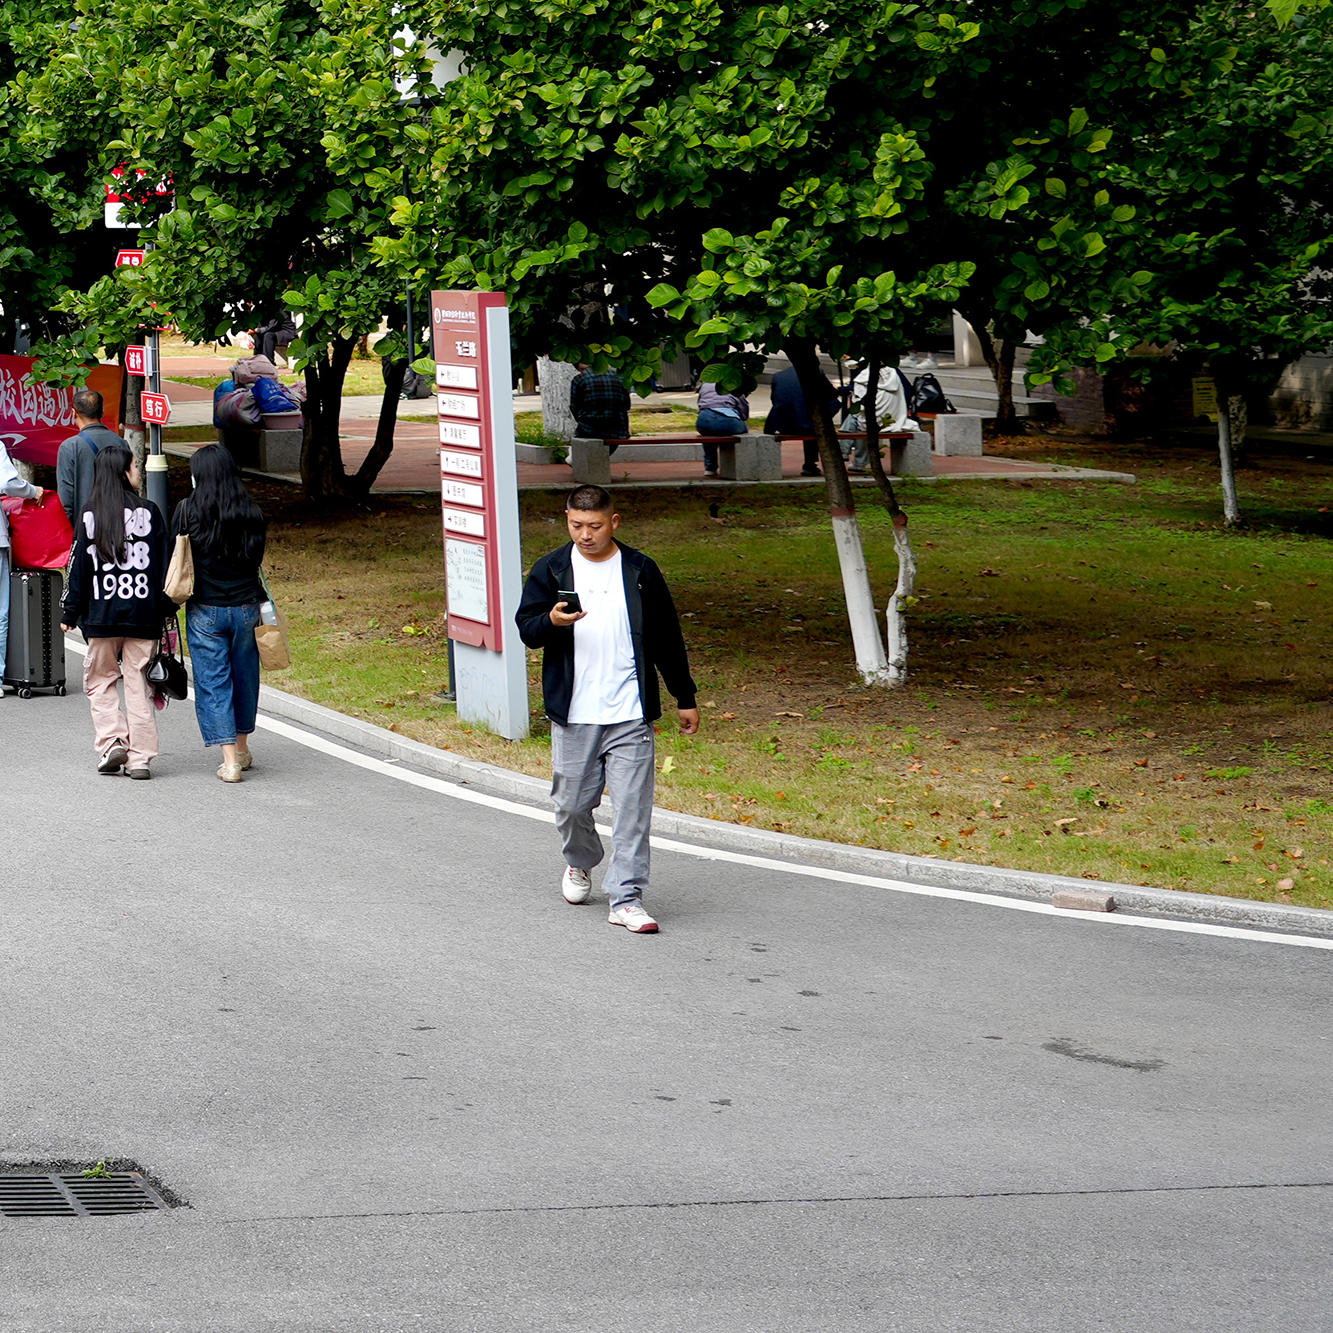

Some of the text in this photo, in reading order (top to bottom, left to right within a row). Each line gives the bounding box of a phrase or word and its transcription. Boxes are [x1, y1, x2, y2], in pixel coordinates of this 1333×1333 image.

[455, 341, 477, 358] 玉兰路
[145, 398, 163, 418] 笃行
[93, 572, 149, 600] 1988
